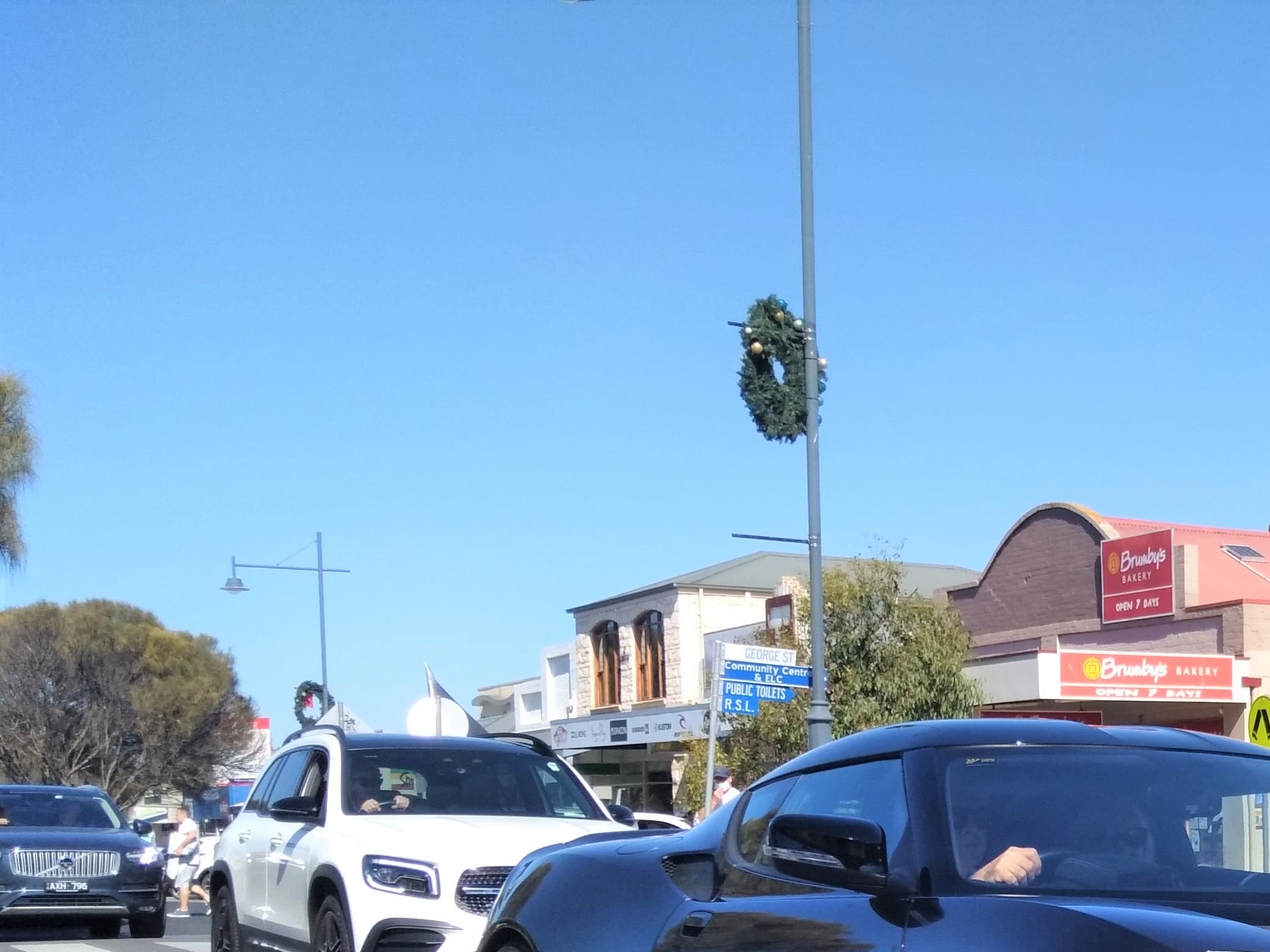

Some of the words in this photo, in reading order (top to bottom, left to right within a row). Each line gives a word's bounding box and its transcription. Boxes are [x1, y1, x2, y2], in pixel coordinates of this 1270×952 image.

[1120, 547, 1166, 572] Brumby's
[1122, 571, 1152, 584] BAKERY
[1115, 601, 1133, 612] OPEN
[1135, 599, 1141, 609] 7
[1143, 597, 1160, 609] DAYS
[744, 647, 781, 661] GEORGE
[783, 652, 794, 664] ST
[725, 661, 779, 676] Community
[782, 667, 810, 677] Centr
[1100, 657, 1168, 683] Brumby's
[1175, 666, 1218, 677] BAKERY
[754, 673, 762, 681] &
[765, 674, 783, 684] ELC
[725, 682, 754, 697] PUBLIC
[757, 685, 786, 700] TOILETS
[1095, 688, 1139, 697] OPEN
[1148, 689, 1158, 697] 7
[1166, 690, 1202, 698] DAYS
[724, 699, 755, 713] R.S.L.
